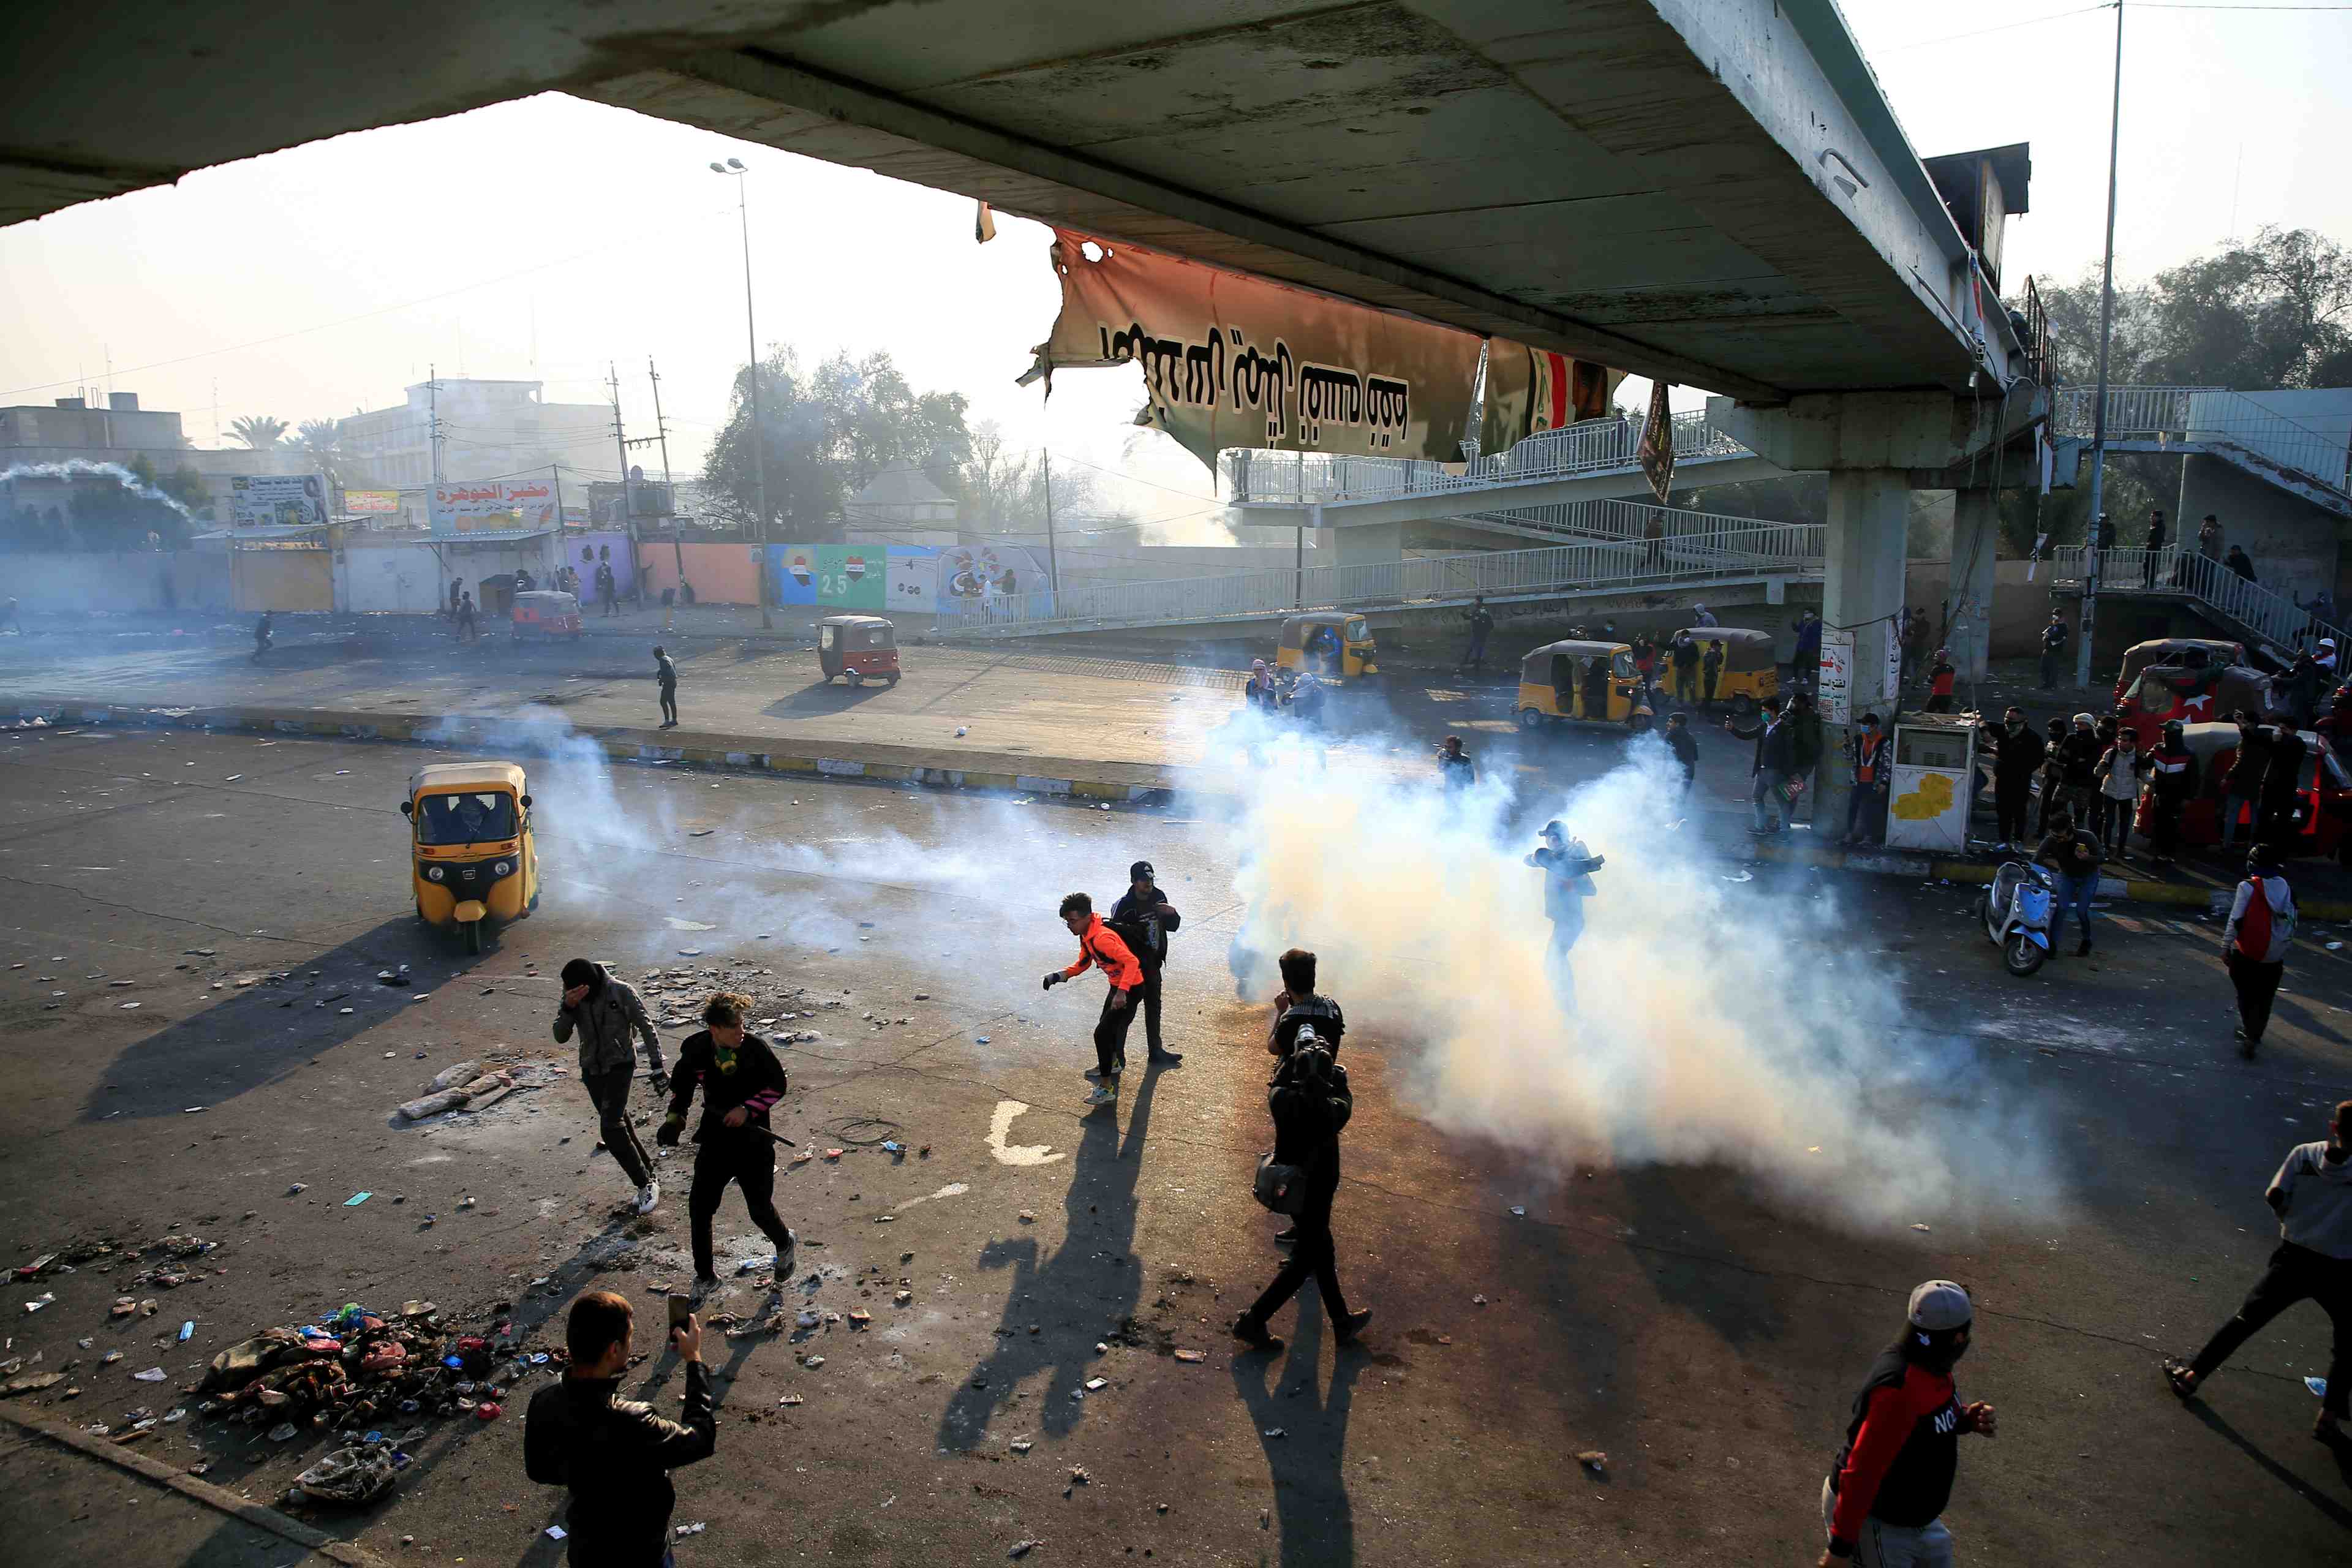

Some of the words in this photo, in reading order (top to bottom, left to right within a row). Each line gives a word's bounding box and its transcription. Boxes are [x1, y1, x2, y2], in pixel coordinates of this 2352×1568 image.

[1231, 328, 1293, 448] يمثل
[1298, 366, 1361, 440] نفسه
[1366, 377, 1408, 447] فقط
